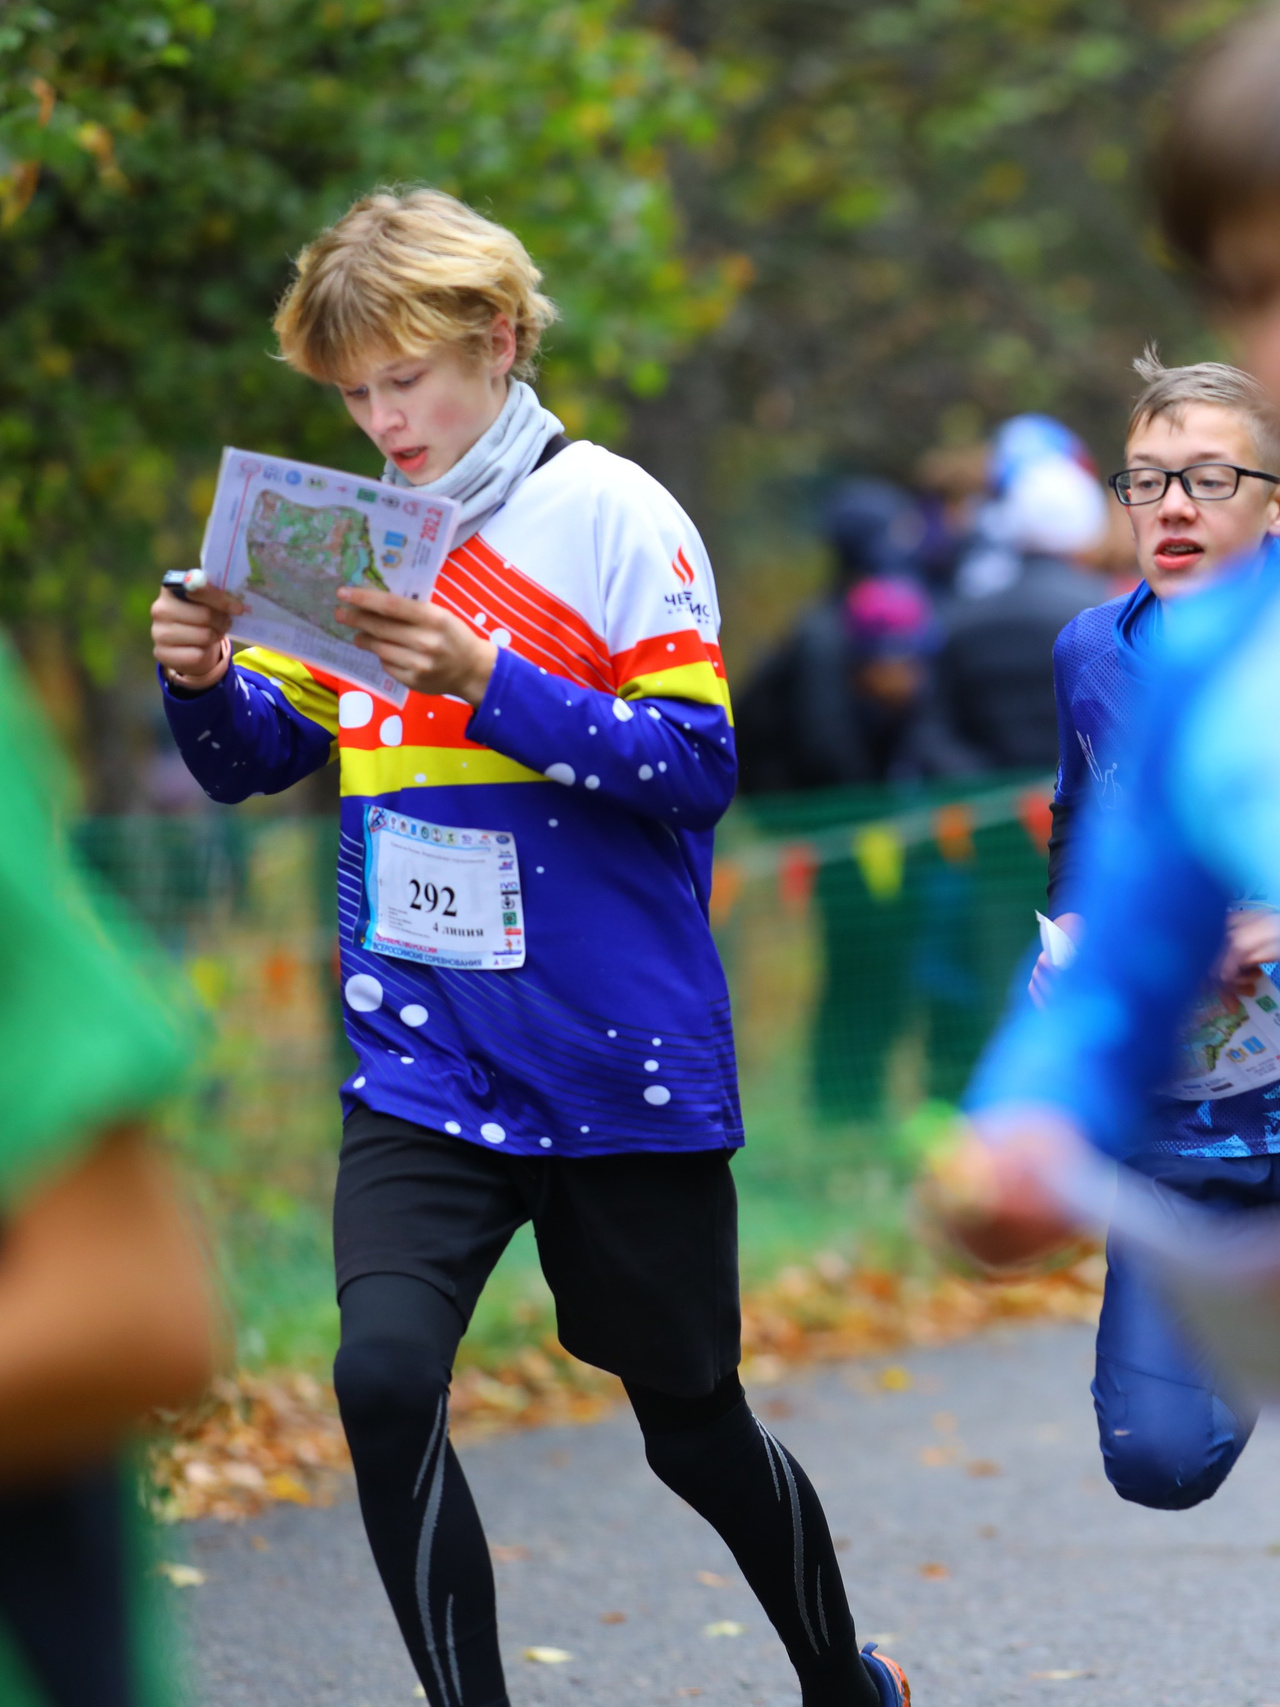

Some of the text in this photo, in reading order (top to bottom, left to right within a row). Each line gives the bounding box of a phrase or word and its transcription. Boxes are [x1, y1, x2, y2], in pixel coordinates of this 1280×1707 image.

[409, 879, 457, 917] 292
[433, 922, 484, 937] 4 линия
